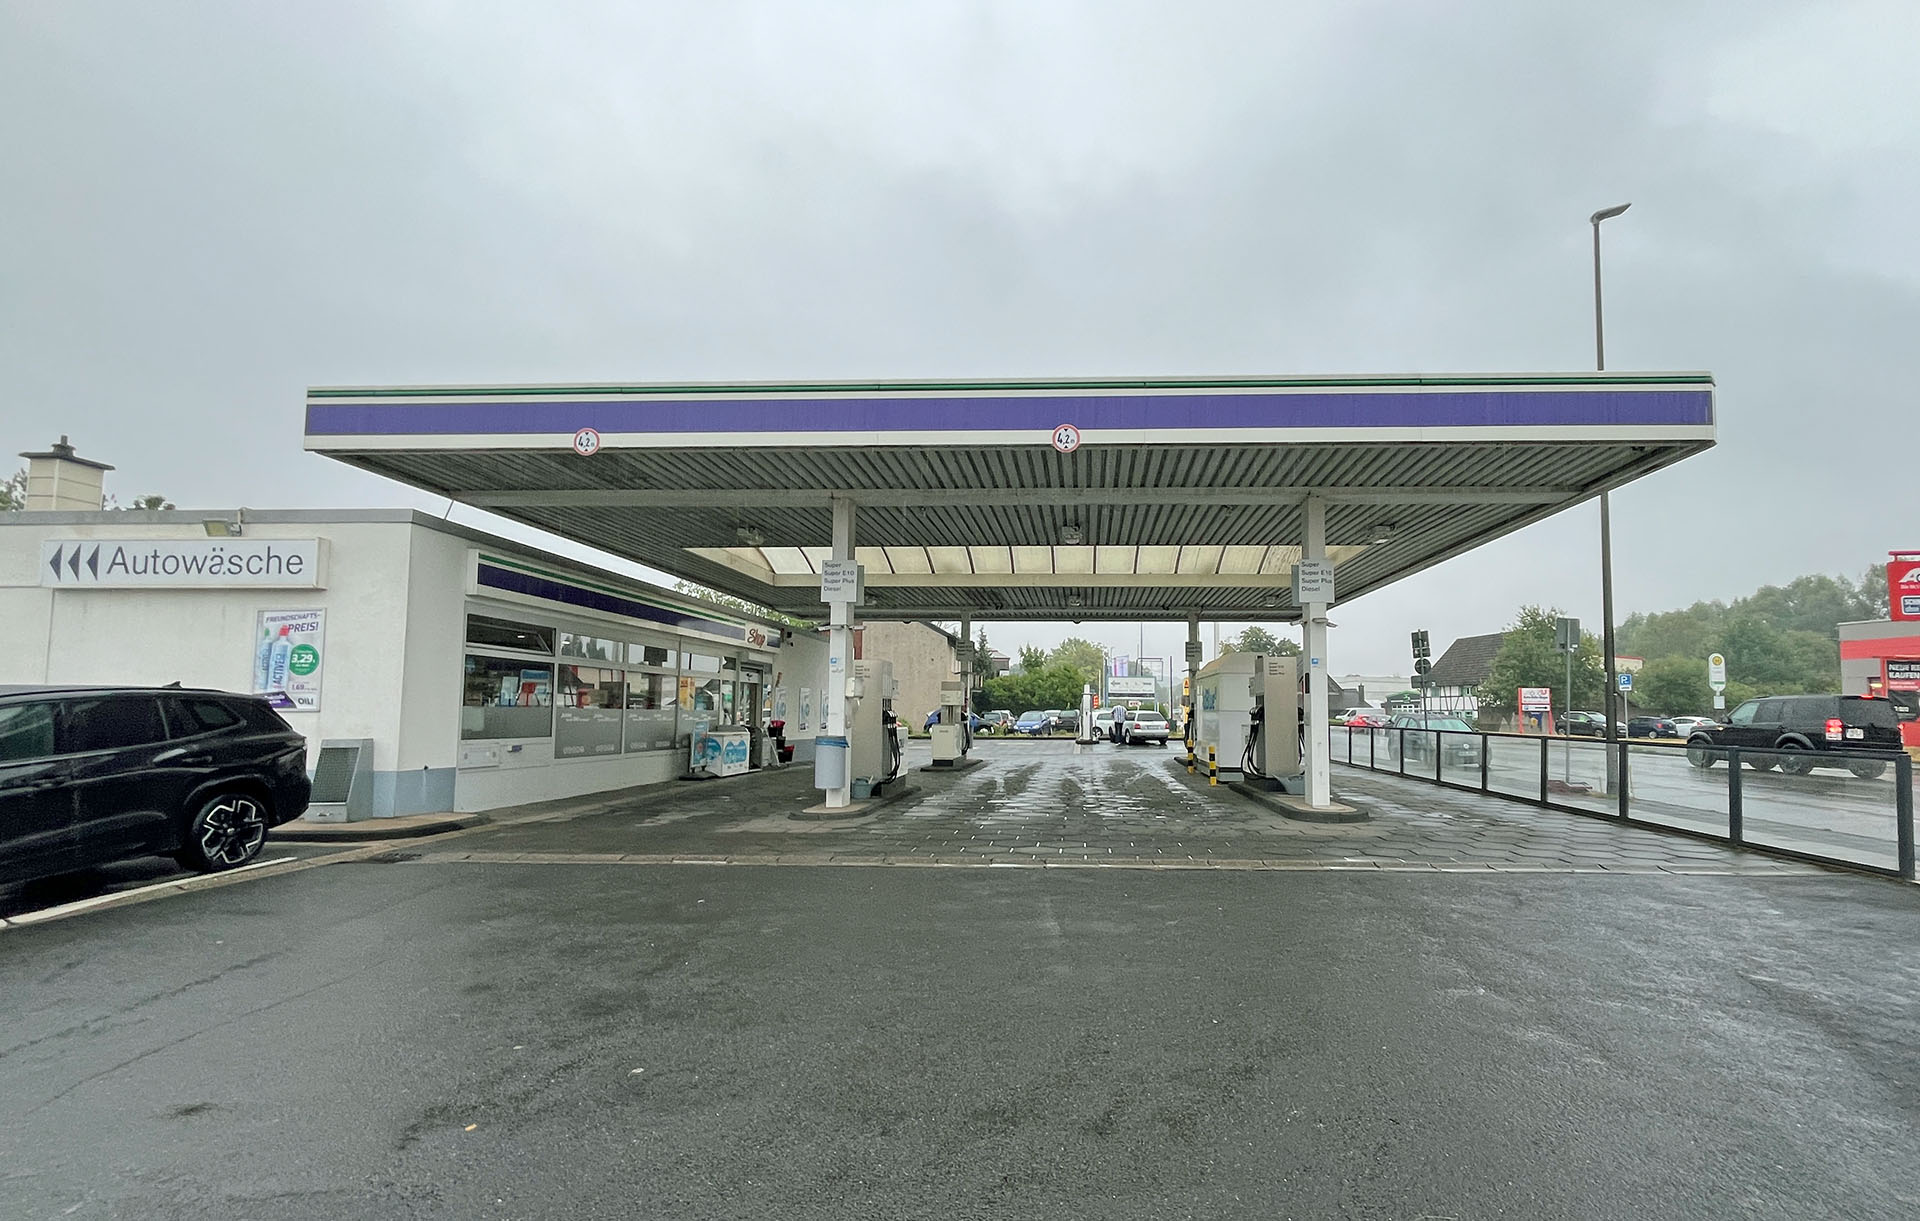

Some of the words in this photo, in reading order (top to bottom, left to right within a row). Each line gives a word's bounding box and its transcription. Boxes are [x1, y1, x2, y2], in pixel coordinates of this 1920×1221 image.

[106, 546, 304, 576] Autowäsche
[265, 612, 320, 623] FREUNDSCHAFTS-
[288, 622, 318, 632] PREIS!
[747, 628, 766, 648] Shop
